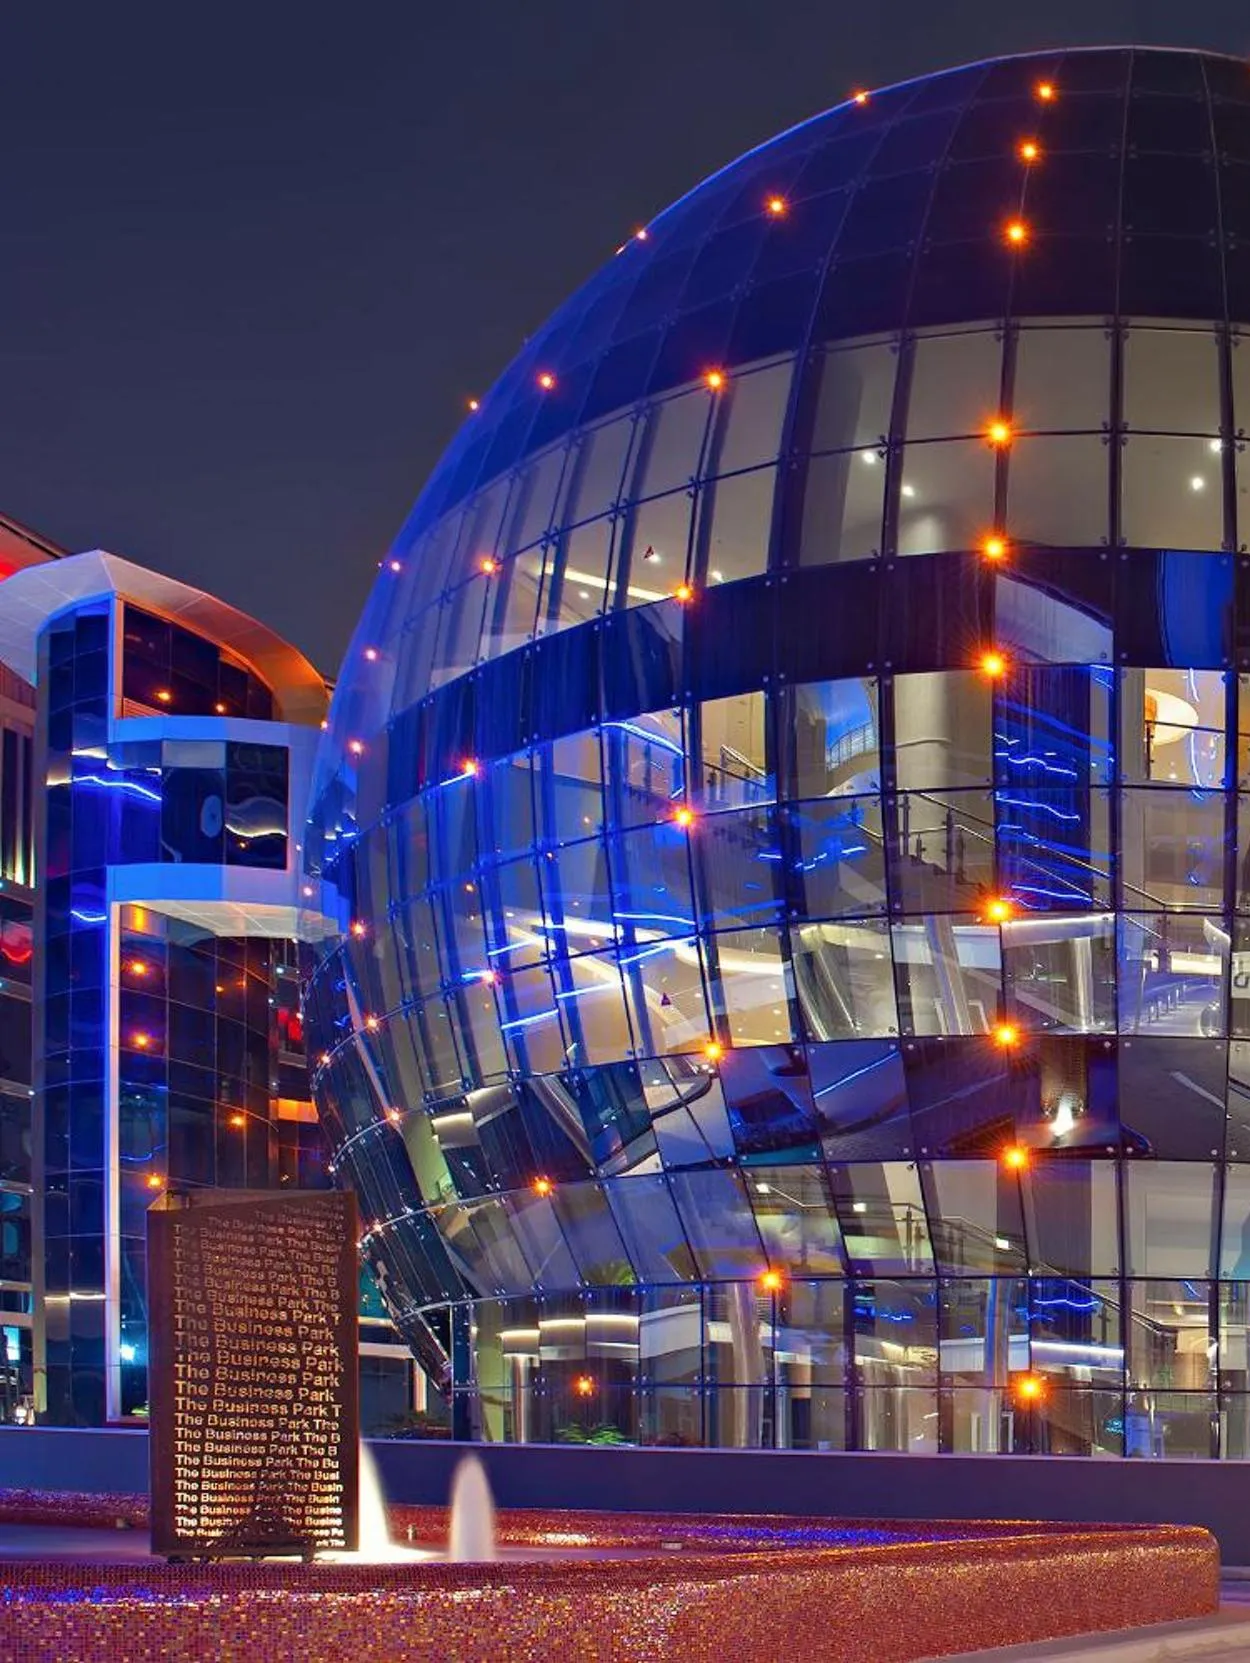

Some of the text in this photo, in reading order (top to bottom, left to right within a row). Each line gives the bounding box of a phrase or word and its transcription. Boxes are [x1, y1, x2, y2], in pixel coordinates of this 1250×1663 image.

[212, 1302, 288, 1321] Business
[292, 1310, 326, 1324] Park
[313, 1300, 338, 1312] The
[175, 1314, 334, 1340] The Business Park
[175, 1331, 339, 1356] The Business Park
[175, 1347, 345, 1372] The Business Park
[175, 1363, 340, 1387] The Business Park
[175, 1380, 335, 1402] The Business Park
[175, 1396, 208, 1411] The
[212, 1399, 289, 1415] Business
[292, 1402, 328, 1417] Park
[175, 1412, 339, 1430] The Business Park The
[175, 1427, 201, 1439] The
[205, 1429, 267, 1441] Business
[271, 1431, 300, 1442] Park
[303, 1432, 328, 1443] The
[175, 1441, 201, 1453] The
[204, 1442, 266, 1454] Business
[269, 1444, 298, 1455] Park
[300, 1445, 325, 1456] The
[175, 1454, 200, 1466] The
[203, 1455, 263, 1467] Business
[266, 1457, 293, 1467] Park
[296, 1457, 319, 1468] The
[175, 1467, 199, 1478] The
[201, 1468, 257, 1479] Business
